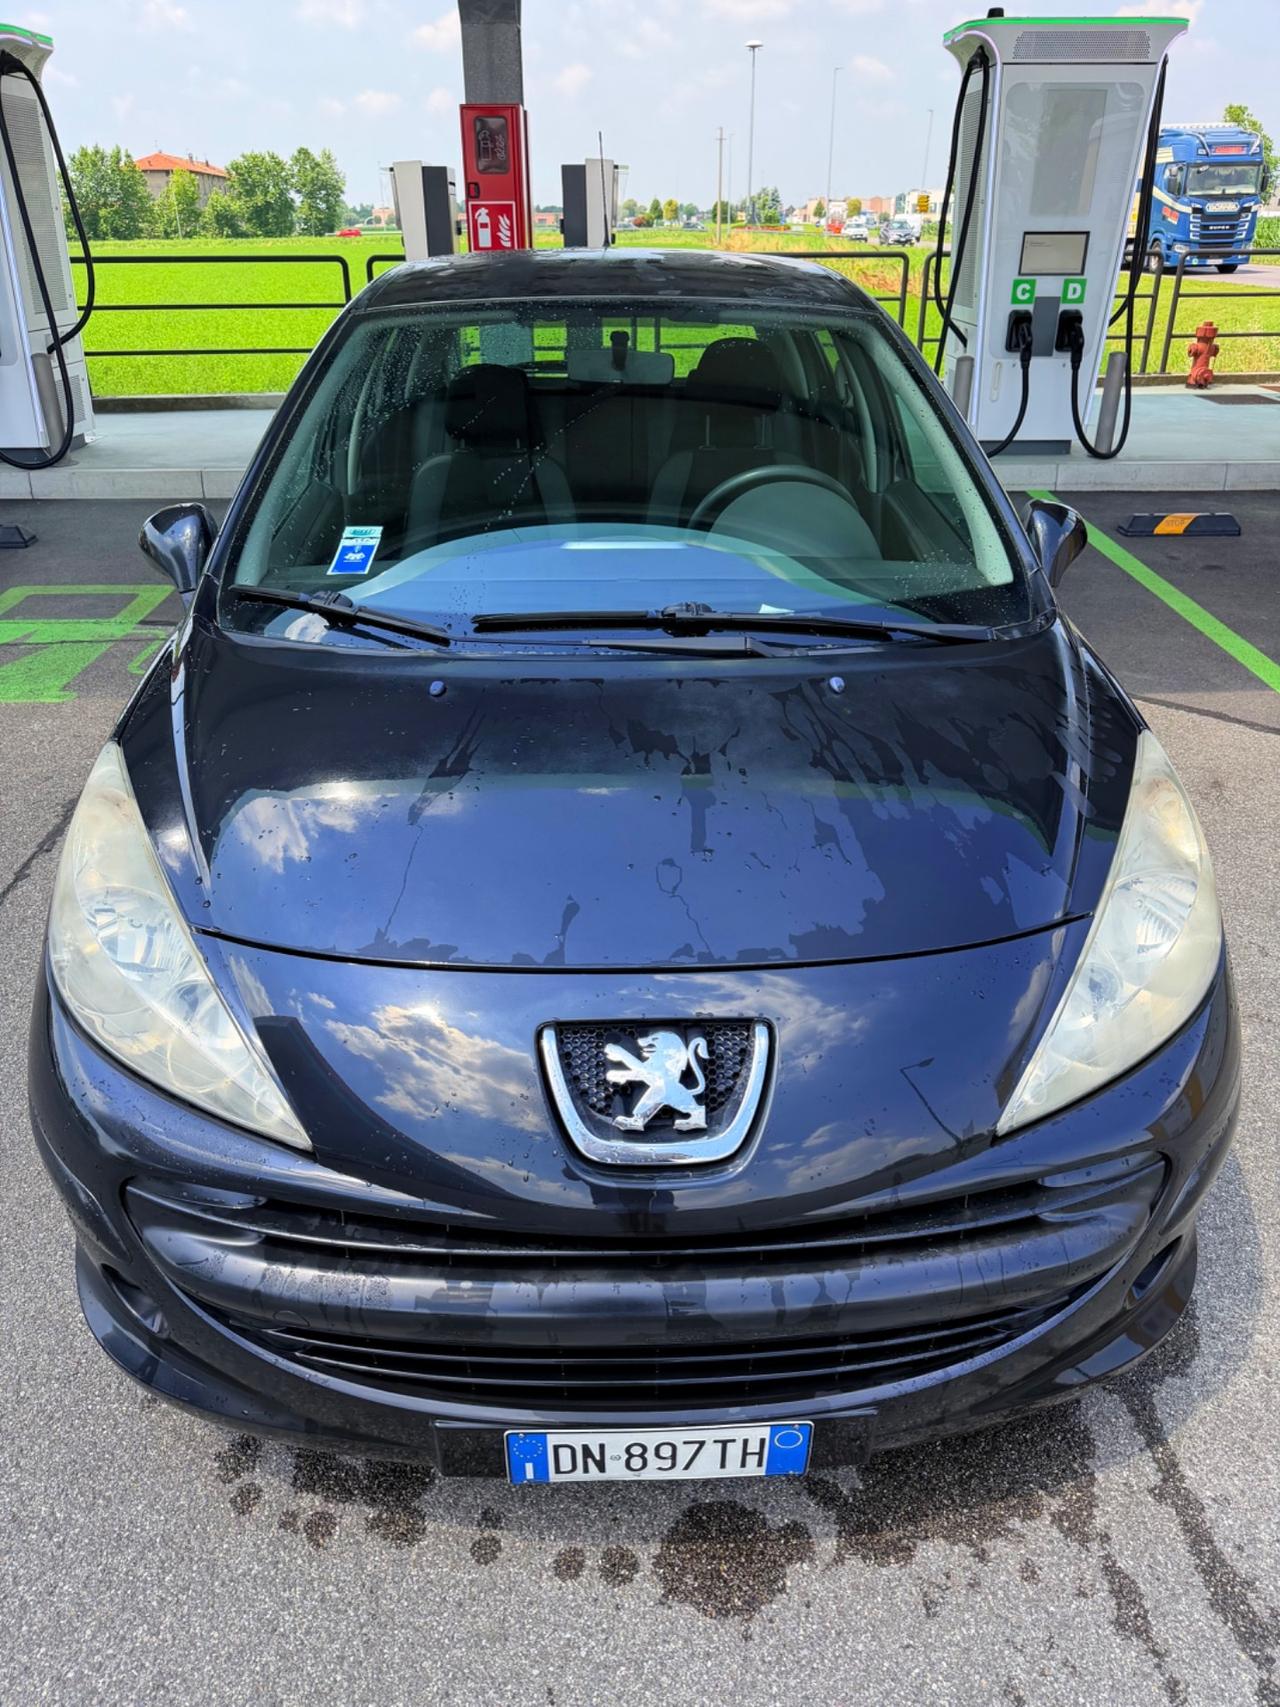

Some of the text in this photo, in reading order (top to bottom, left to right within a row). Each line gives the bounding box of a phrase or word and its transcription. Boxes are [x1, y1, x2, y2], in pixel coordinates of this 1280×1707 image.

[1016, 283, 1031, 300] C
[1067, 283, 1082, 299] D
[1165, 519, 1185, 527] STOP
[552, 1437, 767, 1475] DN 897TH
